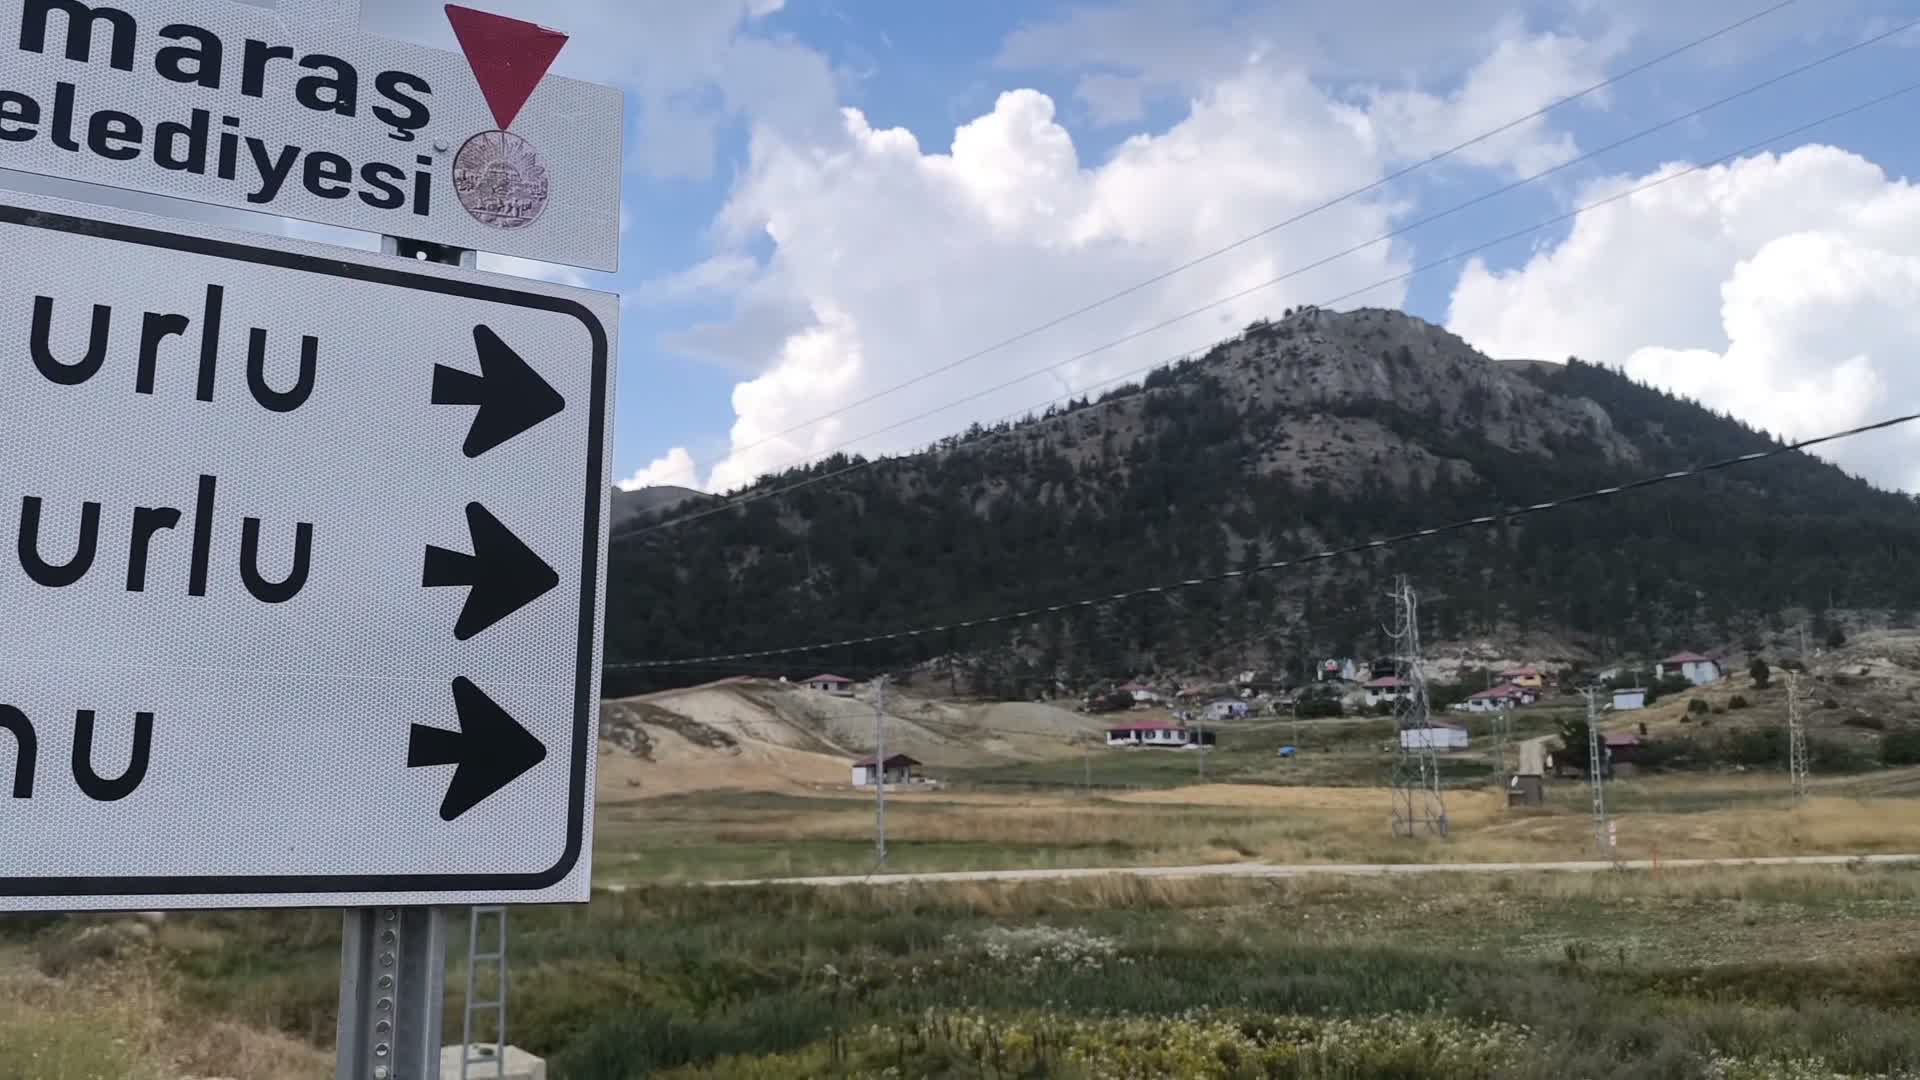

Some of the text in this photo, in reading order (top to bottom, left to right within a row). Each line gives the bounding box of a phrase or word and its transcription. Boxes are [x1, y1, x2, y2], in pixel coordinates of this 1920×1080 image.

[19, 0, 432, 142] maraş
[0, 81, 433, 217] elediyesi
[29, 283, 319, 413] urlu
[17, 474, 313, 604] urlu
